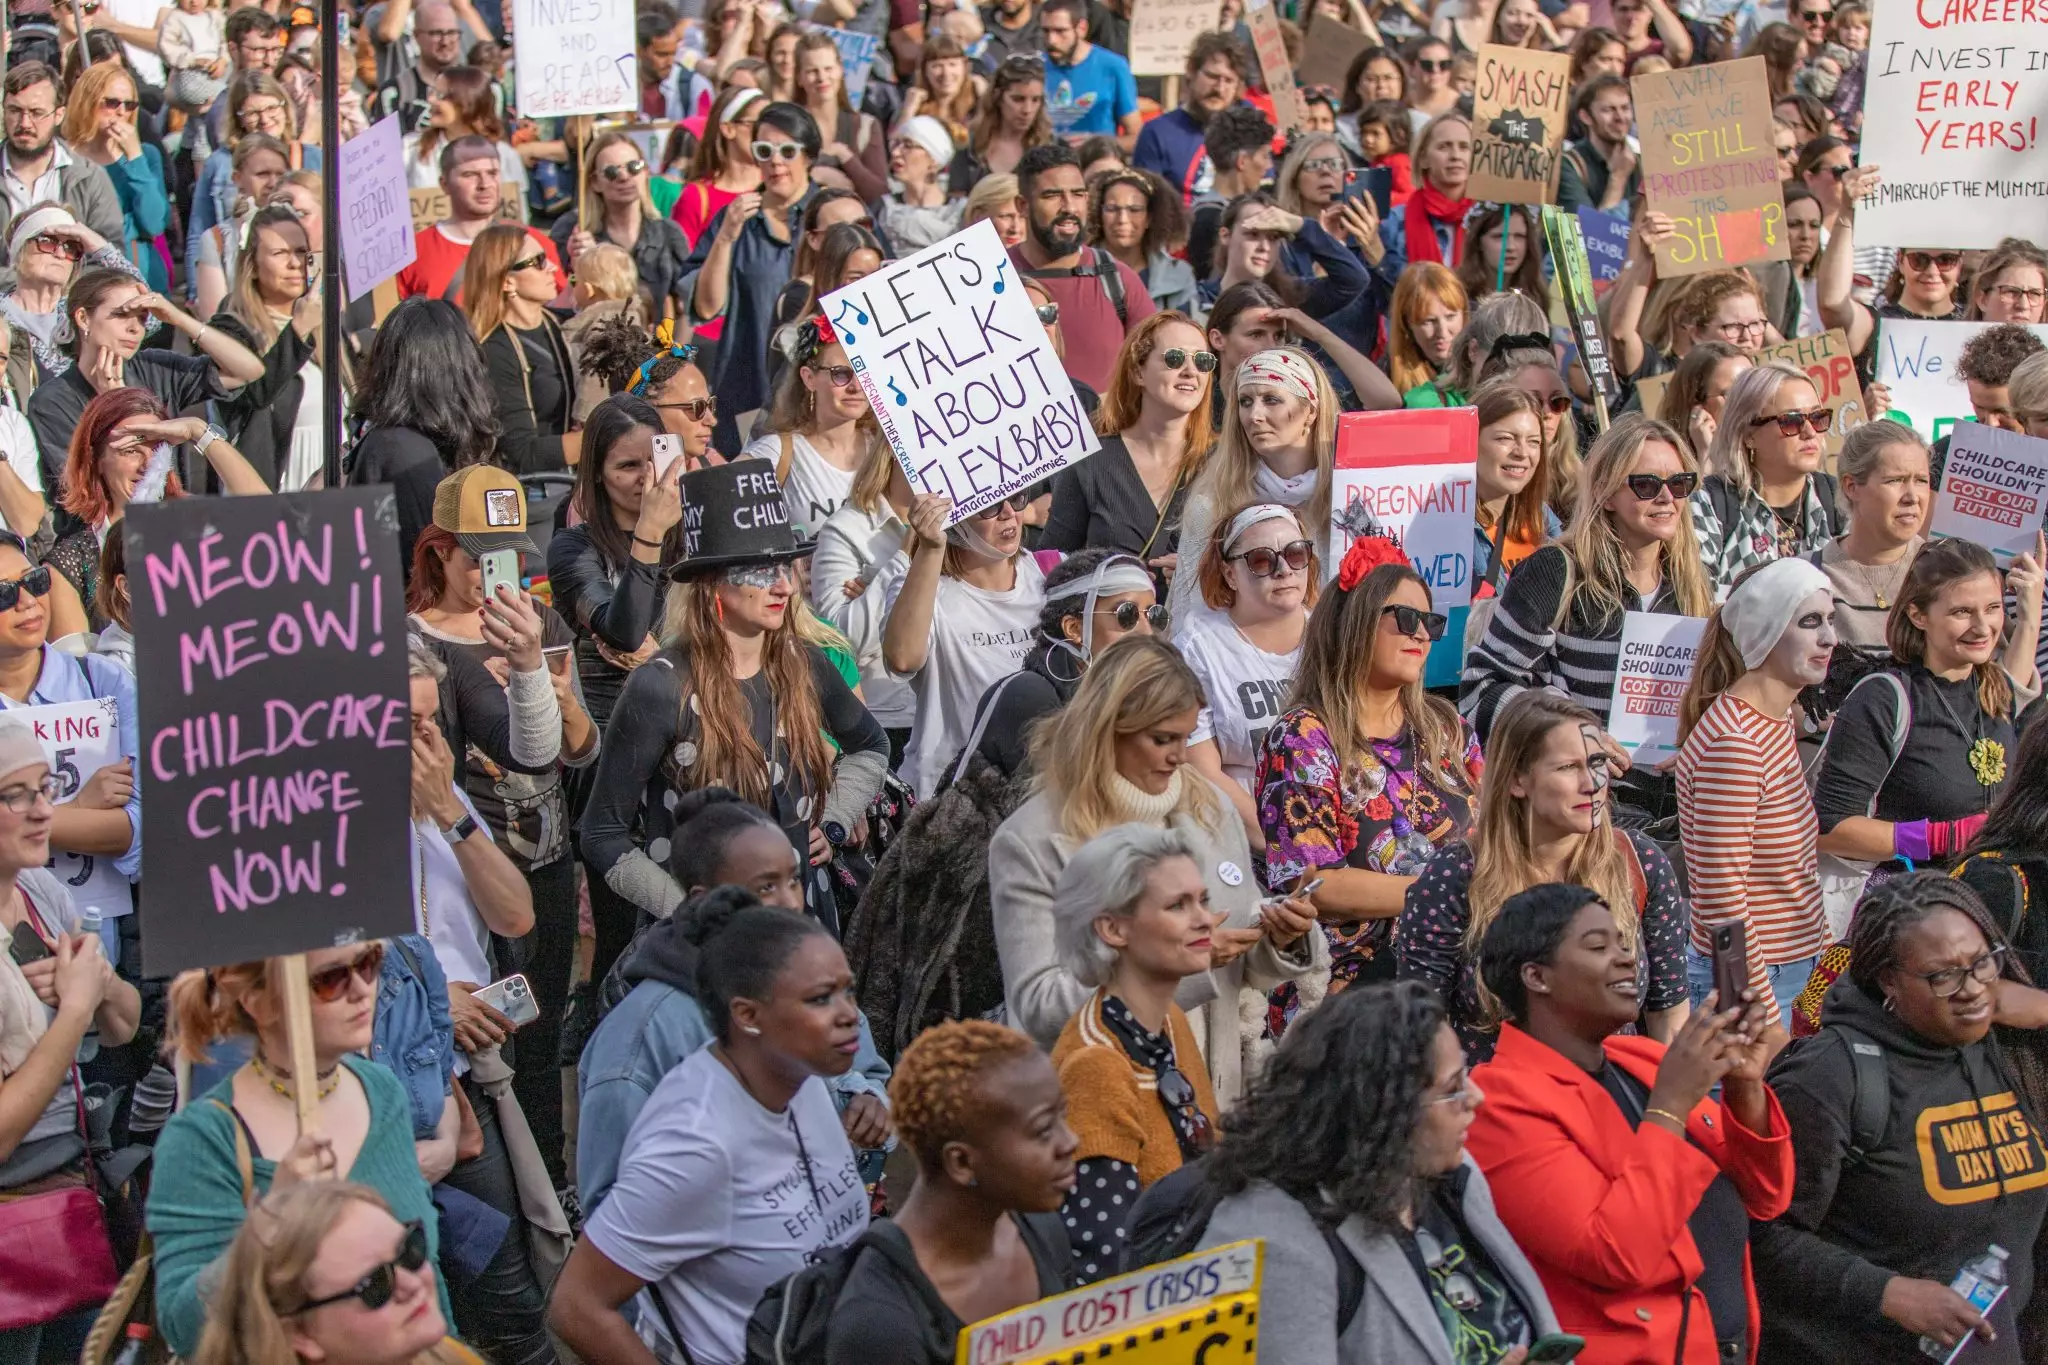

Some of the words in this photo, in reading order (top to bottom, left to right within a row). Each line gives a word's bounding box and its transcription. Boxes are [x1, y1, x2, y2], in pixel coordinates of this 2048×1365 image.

[559, 33, 597, 52] AND
[1878, 41, 2016, 77] INVEST
[1480, 58, 1565, 112] SMASH
[1665, 65, 1729, 100] WHY
[1917, 80, 2019, 112] EARLY
[1504, 119, 1530, 139] THE
[1651, 104, 1695, 133] ARE
[1705, 92, 1744, 120] WE
[1671, 123, 1758, 166] STILL
[1915, 116, 2037, 155] YEARS!
[1469, 138, 1557, 187] PATRIARCHY
[1650, 157, 1777, 200] PROTESTING
[1689, 196, 1729, 214] THIS
[862, 242, 983, 337] LET'S
[883, 300, 1022, 389] TALK
[1889, 334, 1942, 380] We
[912, 347, 1051, 449] ABOUT
[1949, 462, 2046, 495] SHOULDN'T
[1953, 447, 2048, 480] CHILDCARE
[1346, 480, 1472, 516] PREGNANT
[1950, 479, 1997, 500] COST
[1998, 493, 2036, 513] OUR
[1956, 500, 2023, 526] FUTURE
[179, 574, 386, 696] MEOW!
[1625, 642, 1698, 661] CHILDCARE
[1623, 679, 1660, 694] COST
[1628, 699, 1678, 716] FUTURE
[150, 694, 409, 782] CHILDCARE
[187, 769, 364, 840] CHANGE
[208, 813, 349, 914] NOW!
[1955, 1149, 1996, 1184] DAY
[1996, 1140, 2034, 1174] OUT
[976, 1315, 1047, 1365] CHILD
[1062, 1284, 1142, 1339] COST
[1145, 1257, 1222, 1312] CRISIS
